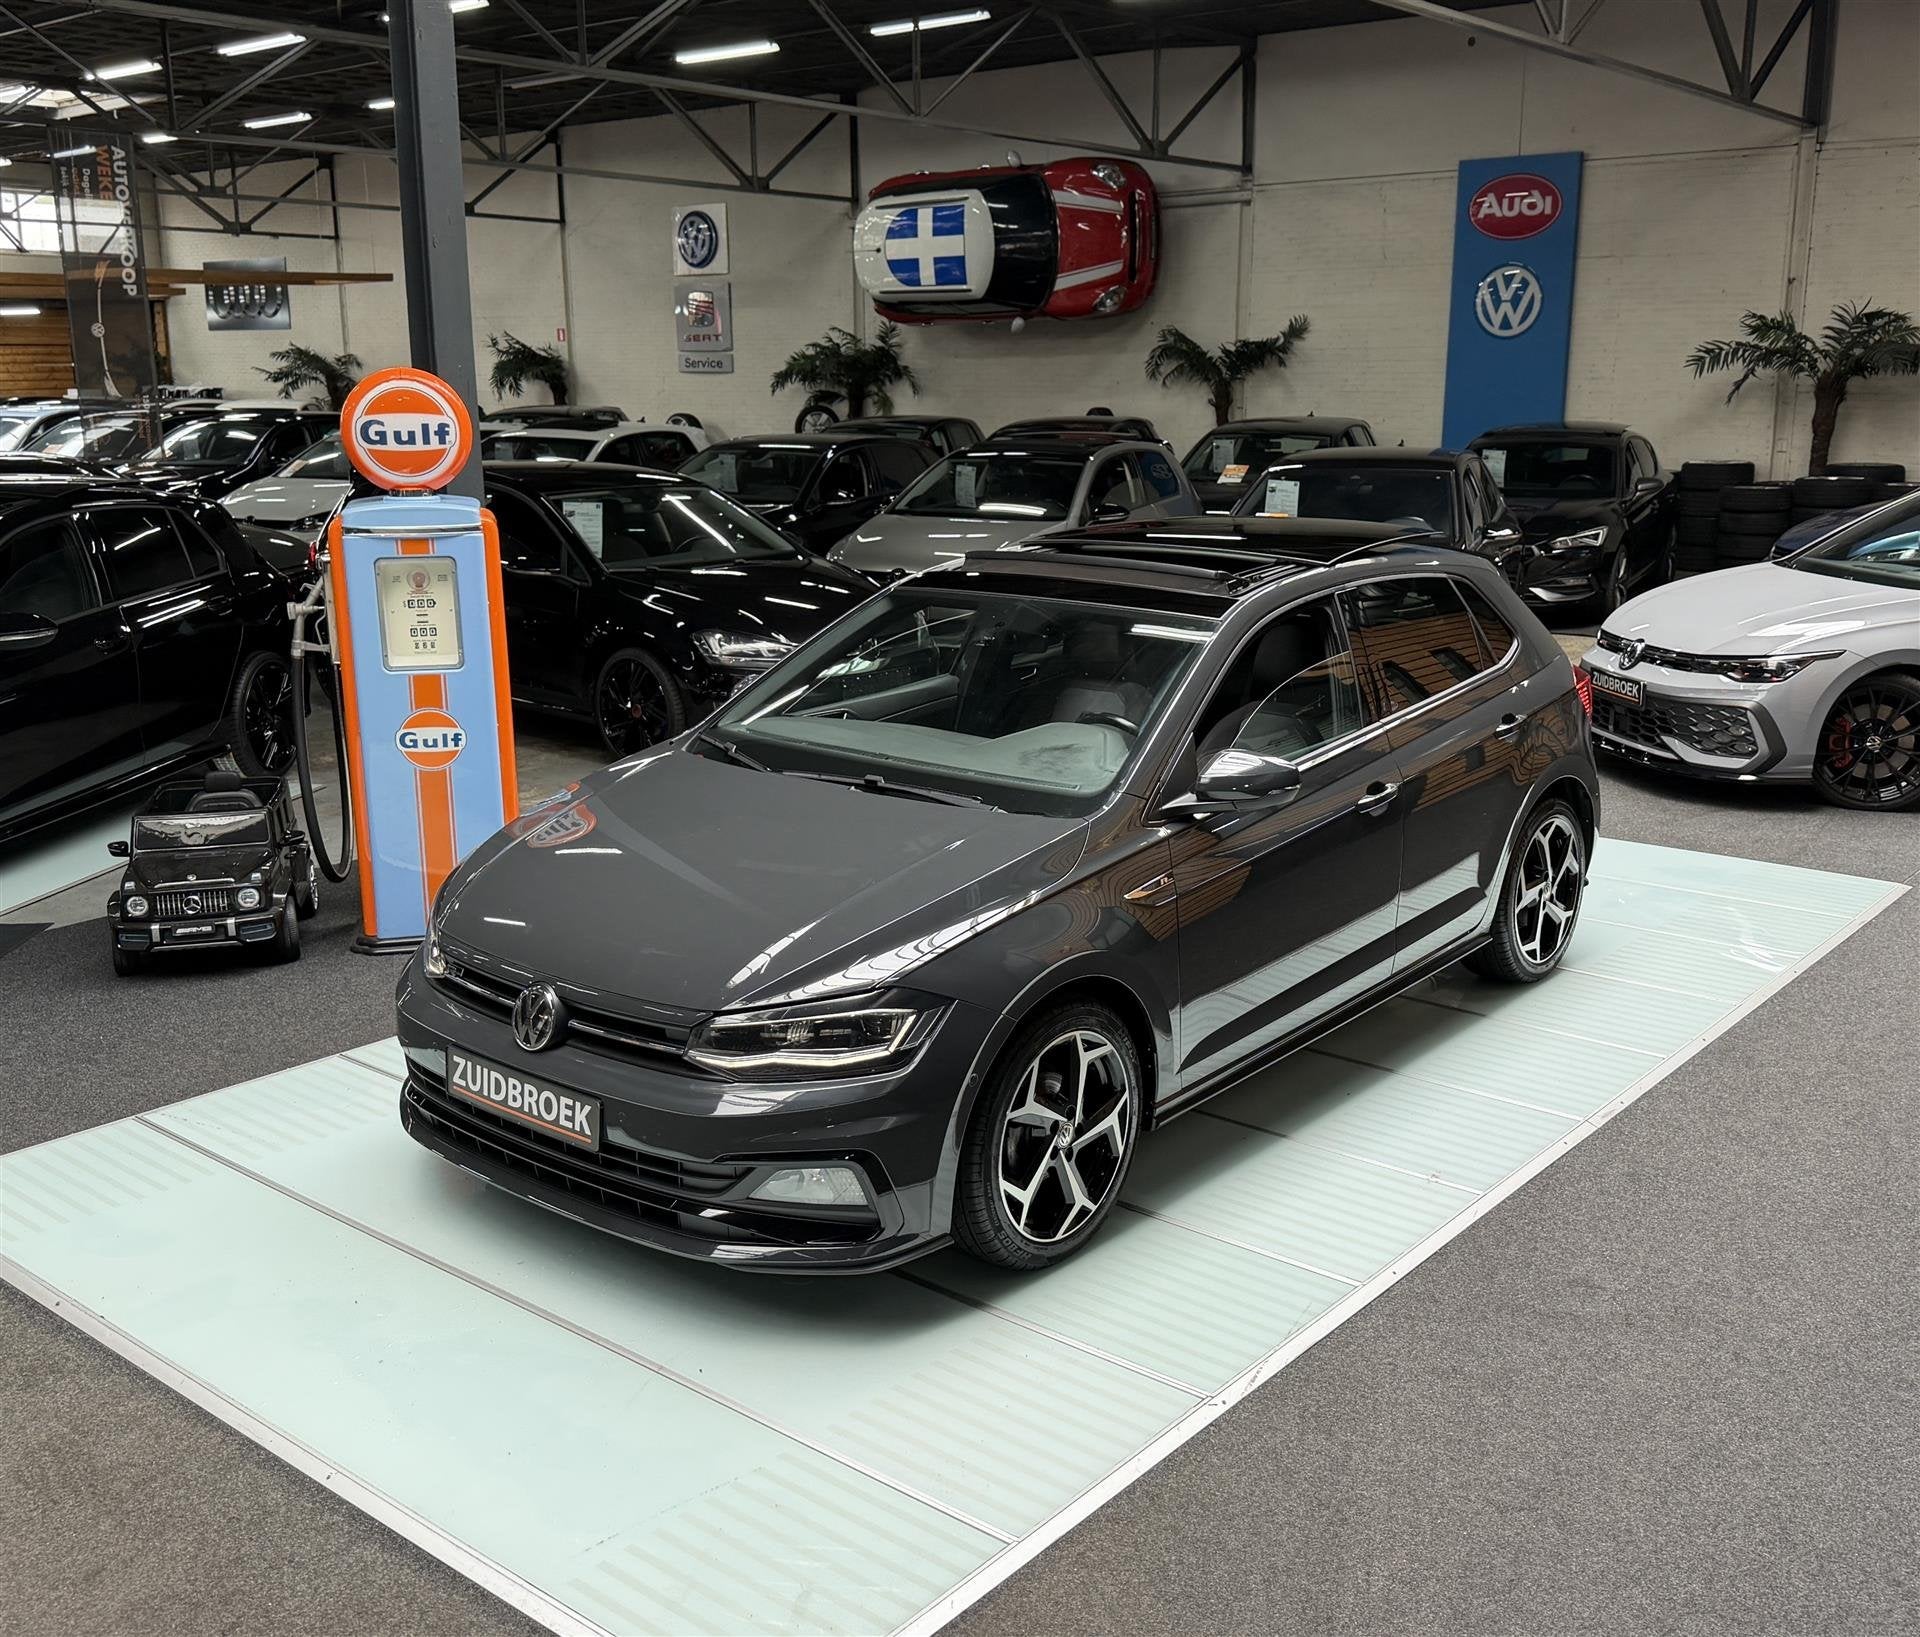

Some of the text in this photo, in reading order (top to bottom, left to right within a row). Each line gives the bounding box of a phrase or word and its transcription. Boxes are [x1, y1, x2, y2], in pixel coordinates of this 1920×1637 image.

[684, 357, 723, 369] Service
[360, 419, 450, 446] Gulf
[1592, 671, 1639, 698] ZUIDBROEK
[399, 731, 462, 748] Gulf
[452, 1055, 593, 1136] ZUIDBROEK
